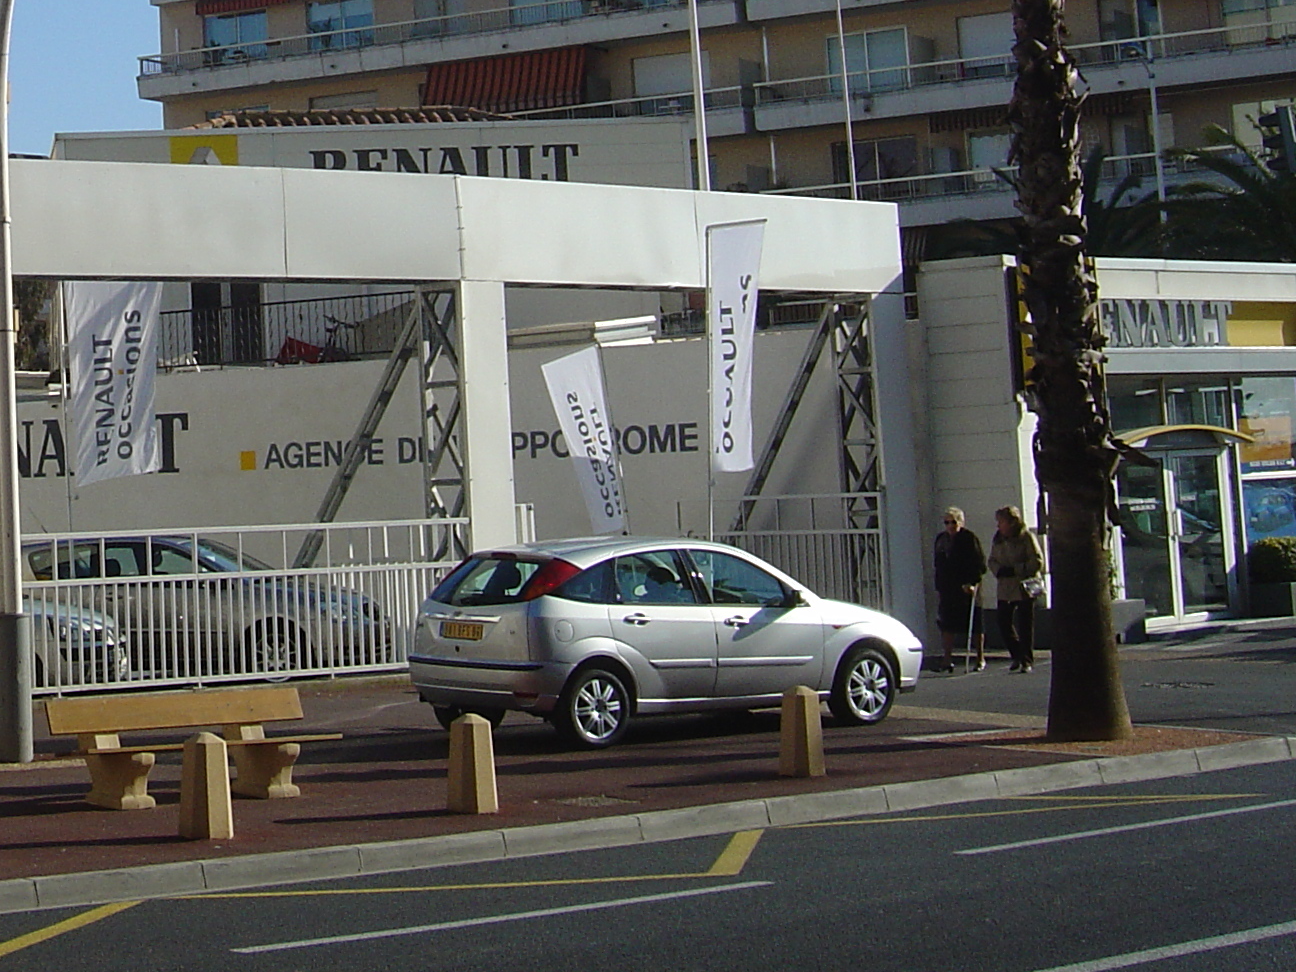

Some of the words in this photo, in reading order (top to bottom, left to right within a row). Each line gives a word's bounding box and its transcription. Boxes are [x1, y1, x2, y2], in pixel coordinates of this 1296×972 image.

[117, 309, 141, 459] occasions
[1102, 299, 1232, 347] ENAULT
[92, 334, 114, 466] RENAULT
